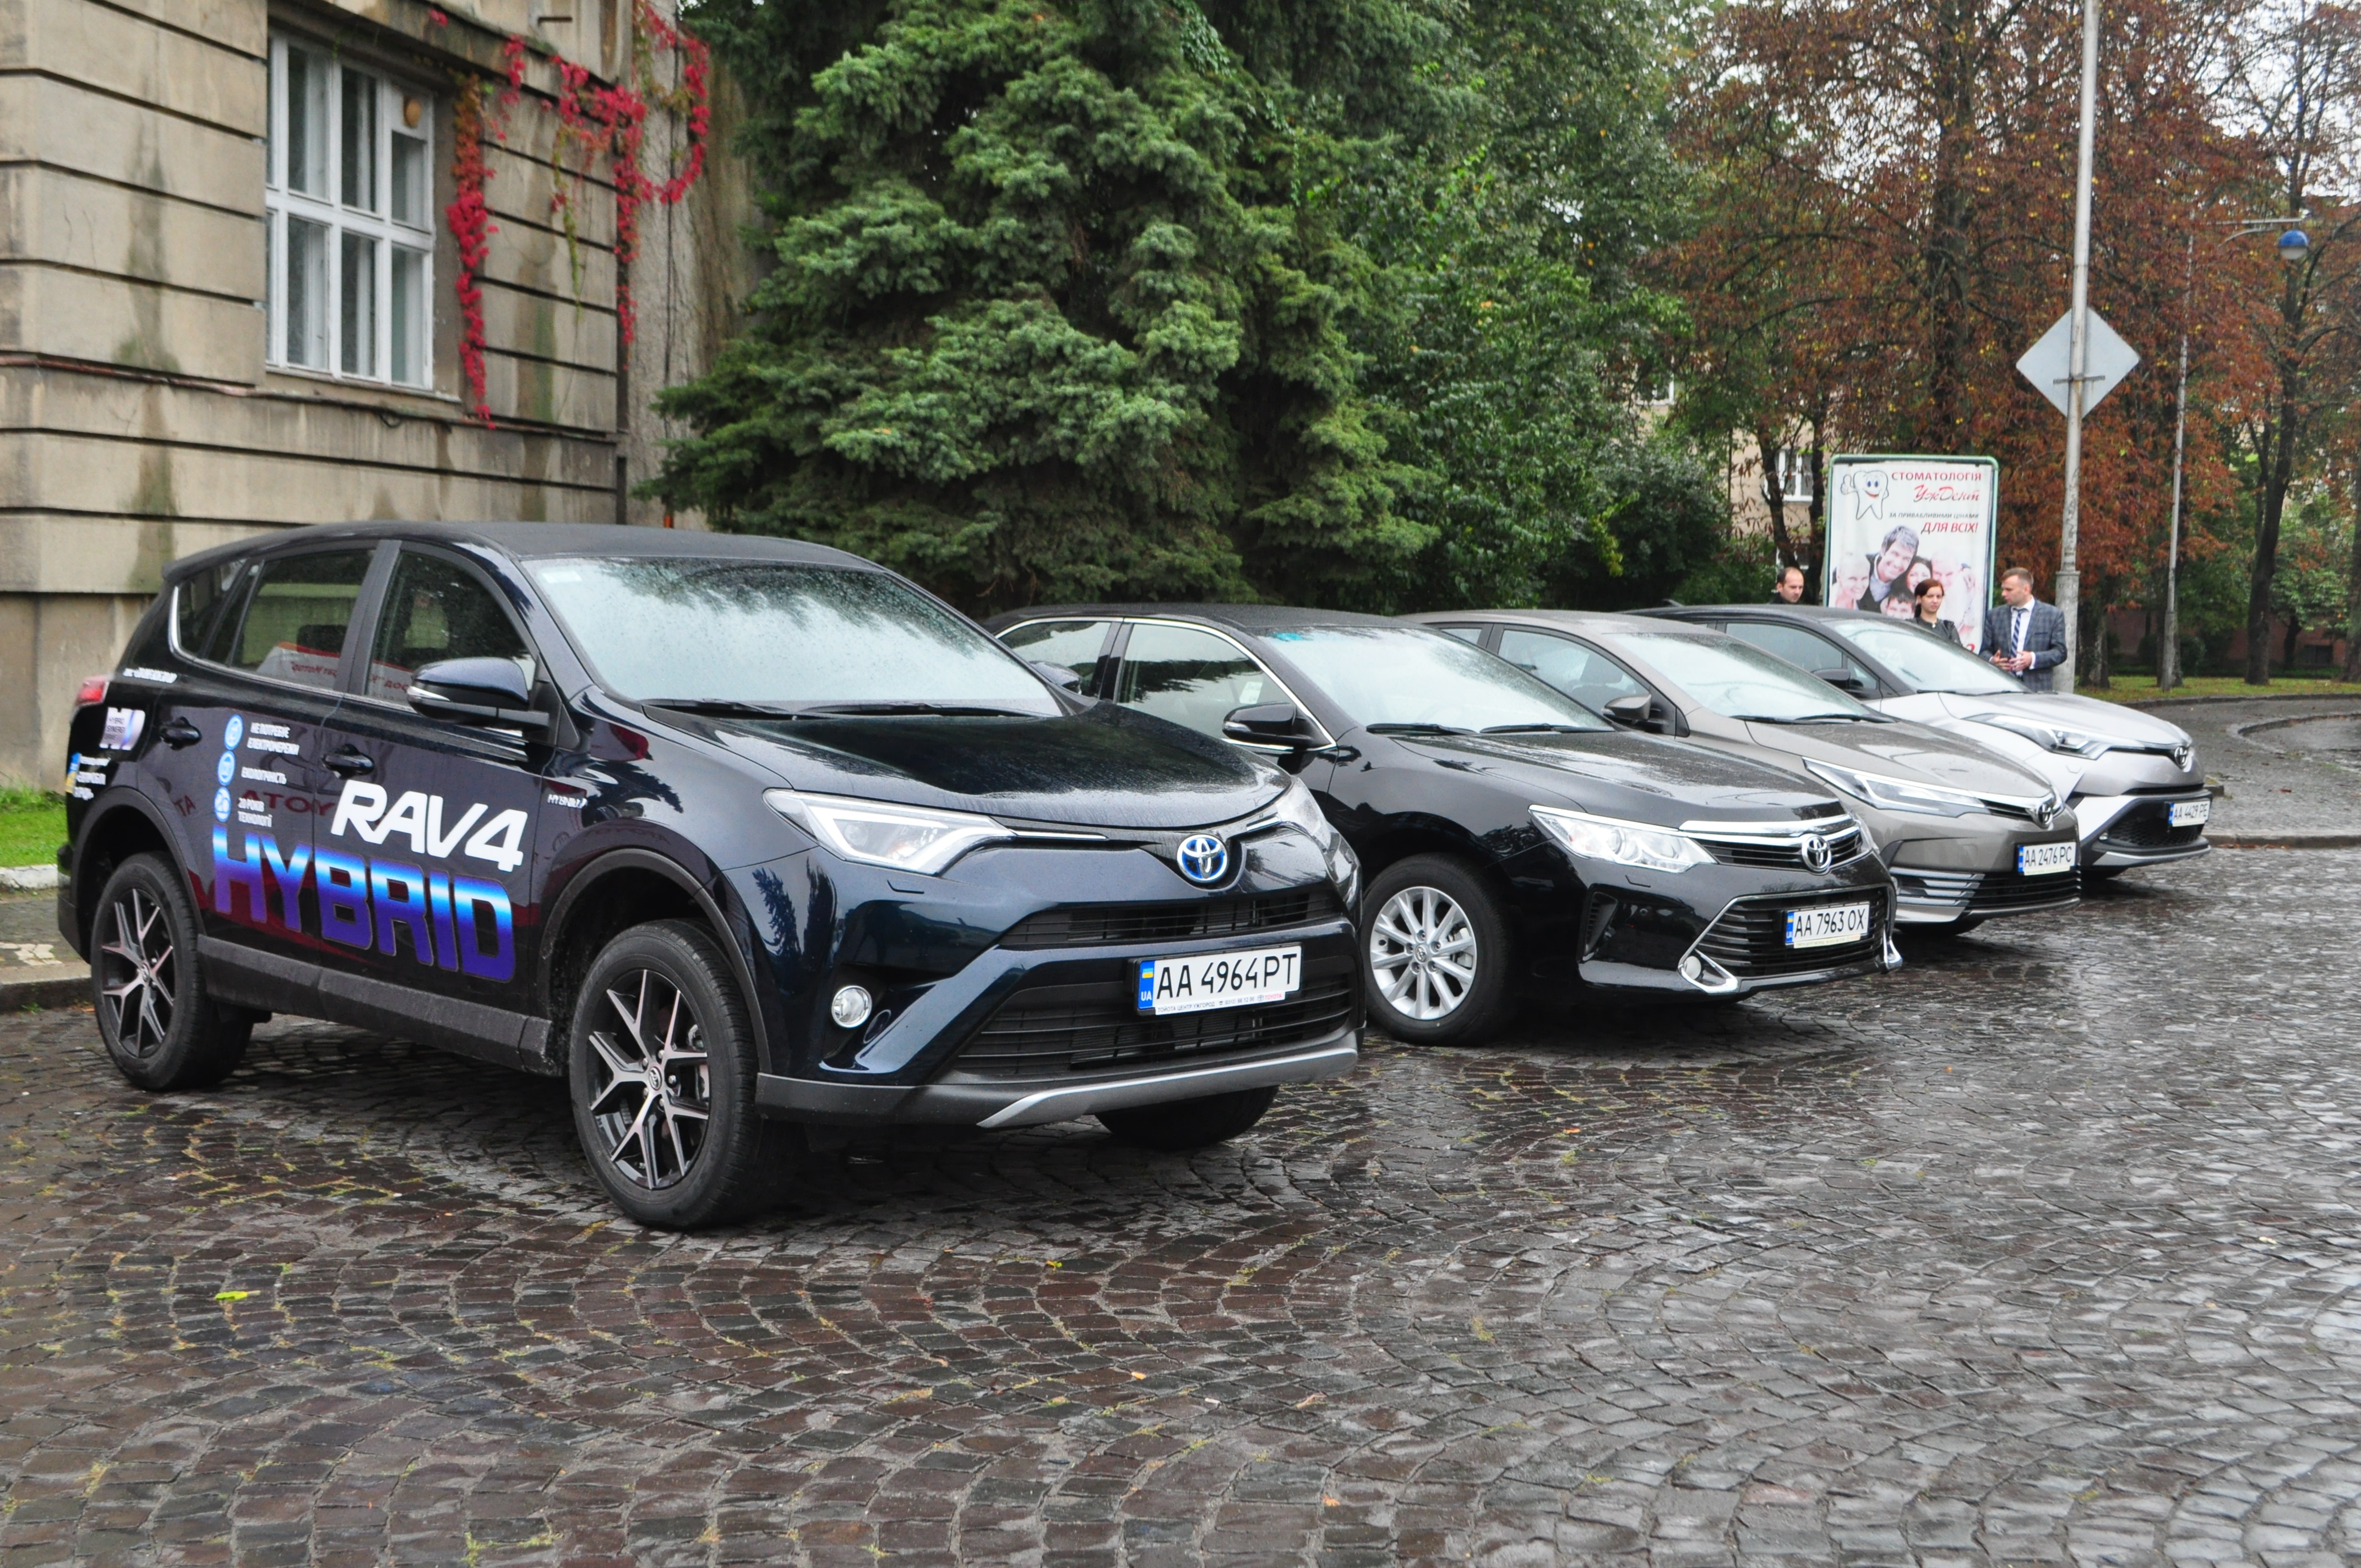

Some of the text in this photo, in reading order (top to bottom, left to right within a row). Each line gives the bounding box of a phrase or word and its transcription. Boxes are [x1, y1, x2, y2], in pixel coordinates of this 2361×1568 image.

[1891, 472, 1982, 481] СТОМАТОЛОГІЯ
[1920, 522, 1979, 535] ДЛЯ ВСІХ!
[330, 780, 528, 873] RAV4
[2024, 846, 2072, 867] AA 2476 PC
[213, 824, 516, 983] HYBRID
[1794, 908, 1865, 938] AA 7963 OX
[1156, 953, 1297, 1000] AA 4964 PT
[1140, 990, 1152, 1001] UA
